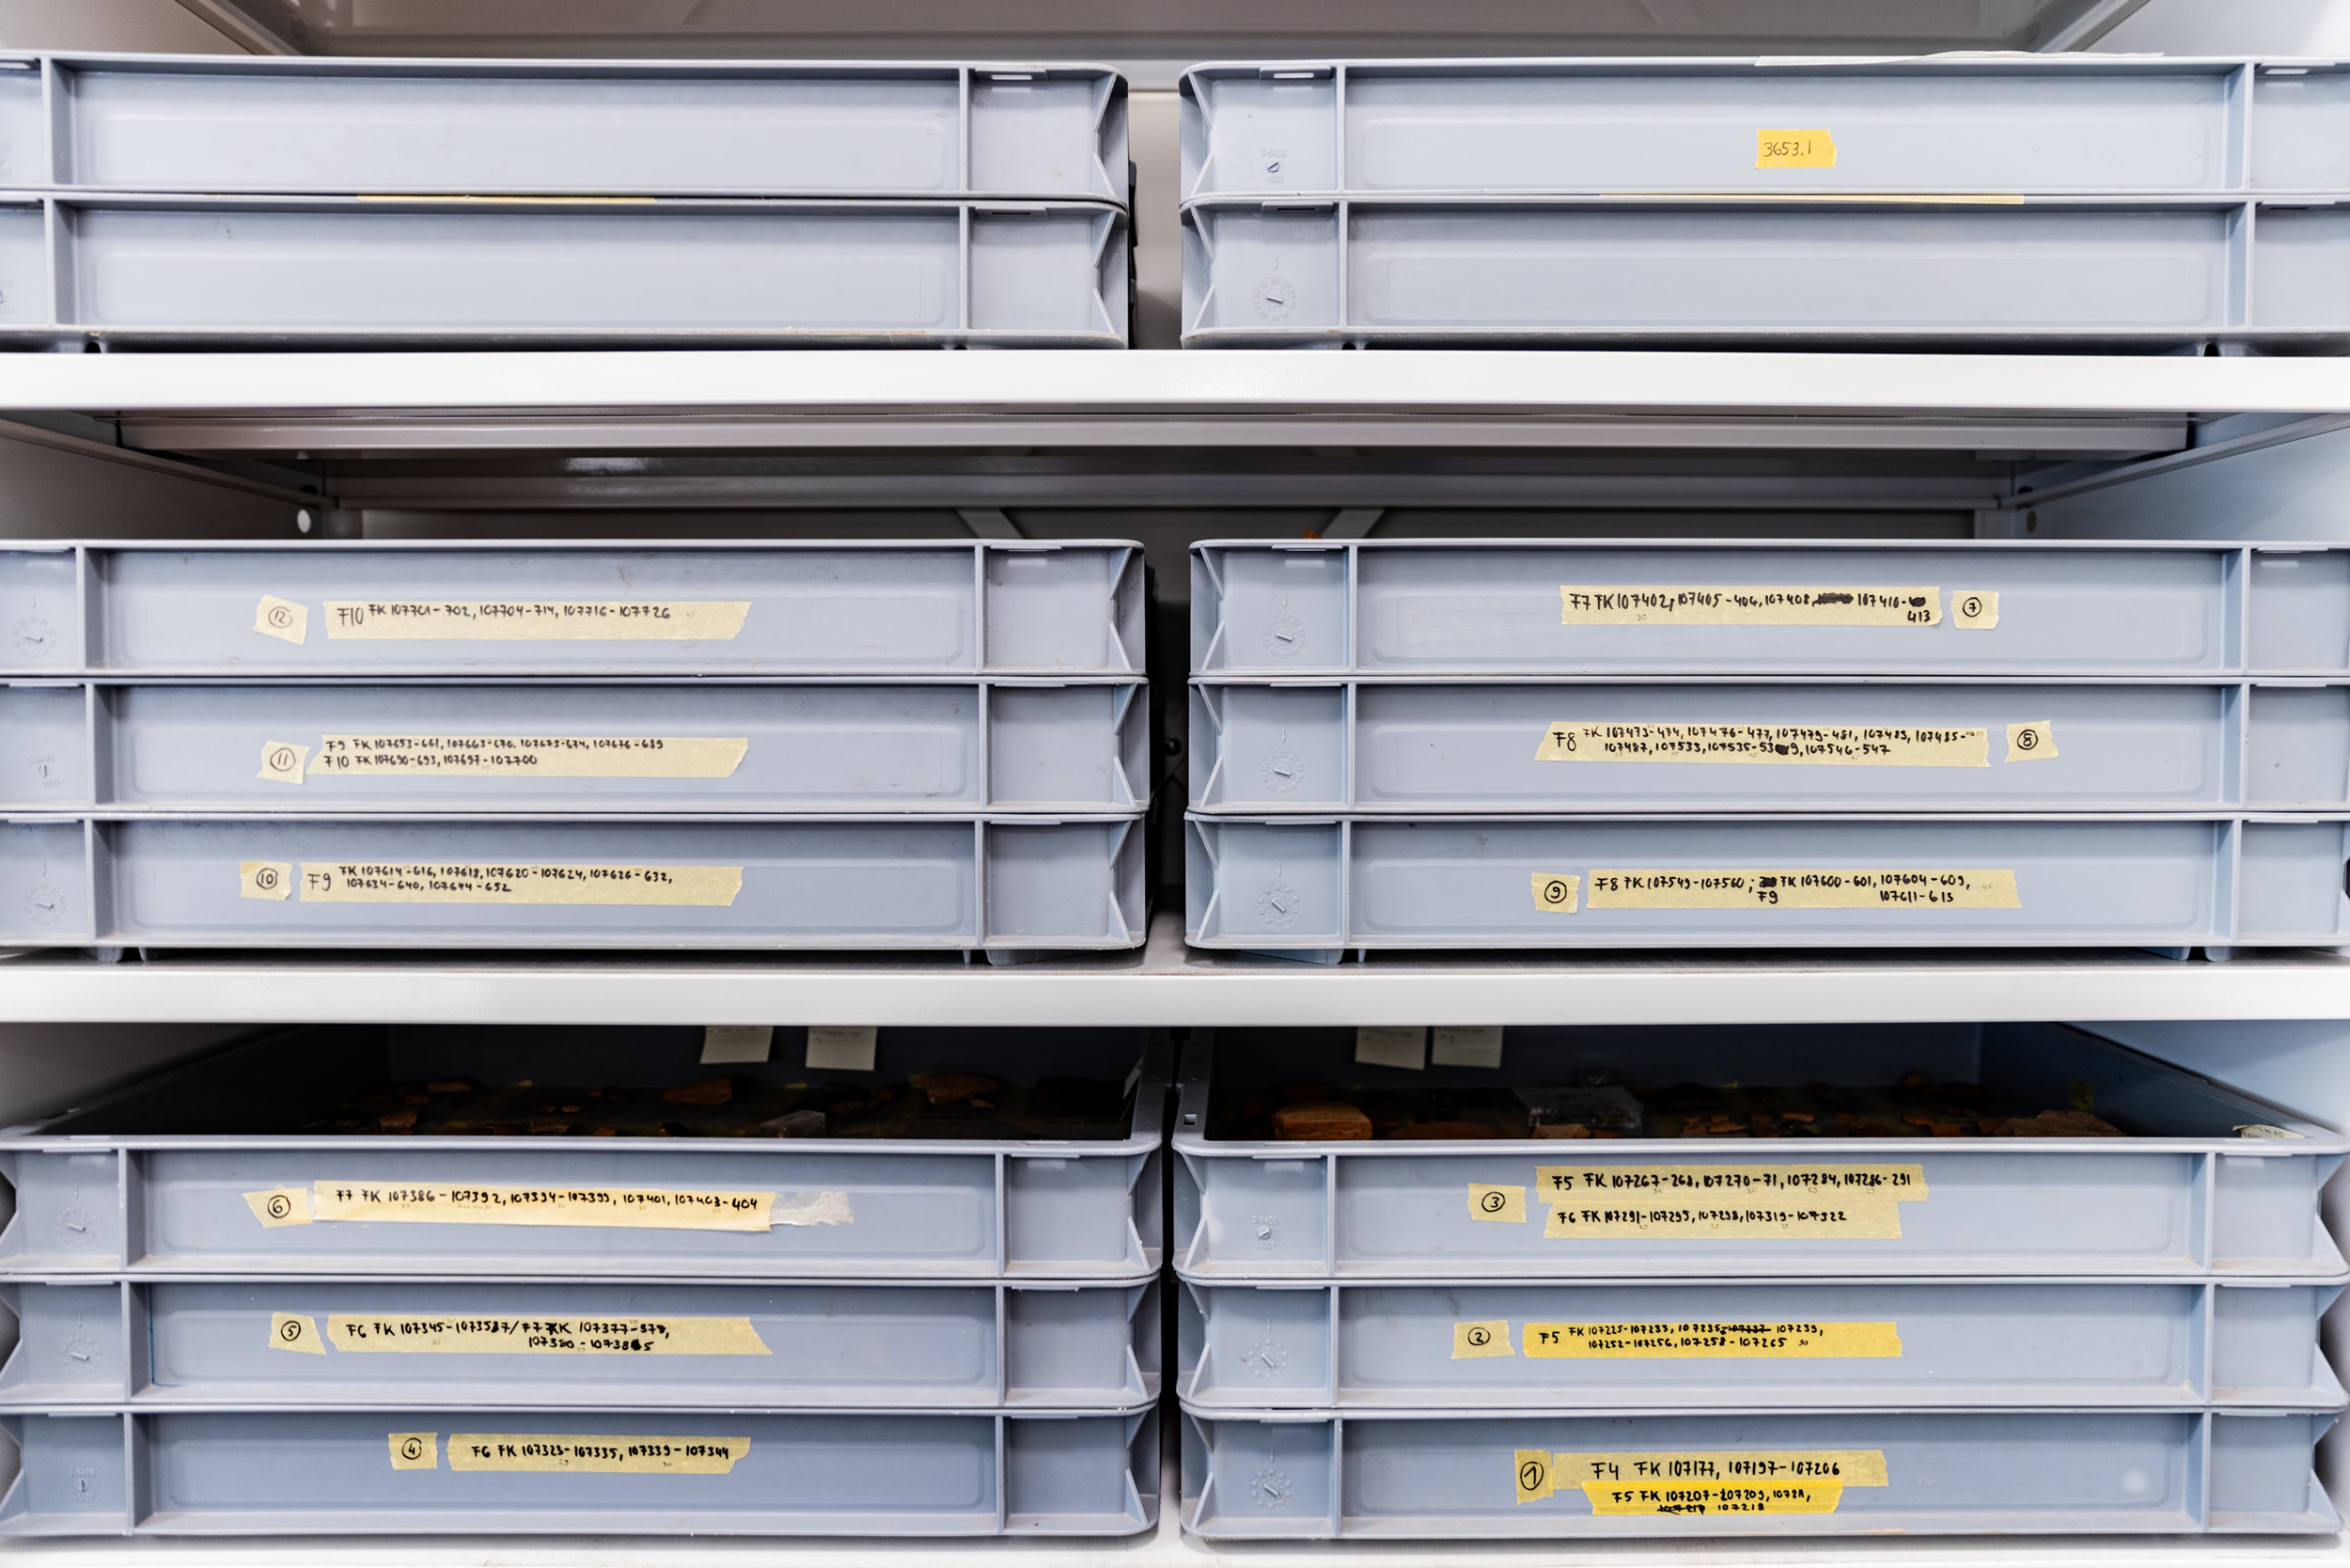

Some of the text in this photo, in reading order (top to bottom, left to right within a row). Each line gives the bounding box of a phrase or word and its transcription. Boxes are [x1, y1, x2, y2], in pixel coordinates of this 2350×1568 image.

[1763, 139, 1811, 157] 3653.1
[1594, 593, 1614, 610] FK
[337, 606, 364, 626] F10
[368, 604, 386, 616] FK
[1907, 610, 1930, 622] 413
[326, 740, 346, 751] F9
[352, 739, 371, 750] FK
[1553, 731, 1576, 751] F8
[1582, 727, 1602, 738] FK
[355, 756, 372, 765] FK
[339, 866, 357, 876] FK
[307, 872, 331, 891] F9
[1595, 877, 1618, 890] F8
[1624, 877, 1644, 888] FK
[1780, 877, 1796, 887] FK
[1758, 891, 1778, 904] F9
[1552, 1175, 1574, 1190] F5
[1583, 1173, 1606, 1187] FK
[362, 1189, 386, 1203] FK
[1582, 1210, 1601, 1222] FK
[374, 1323, 395, 1336] FK
[1540, 1331, 1559, 1344] F5
[1569, 1327, 1584, 1337] FK
[497, 1445, 517, 1457] FK
[1590, 1463, 1619, 1481] F4
[1633, 1461, 1661, 1477] FK
[1612, 1491, 1635, 1503] F5
[1639, 1491, 1661, 1501] FK
